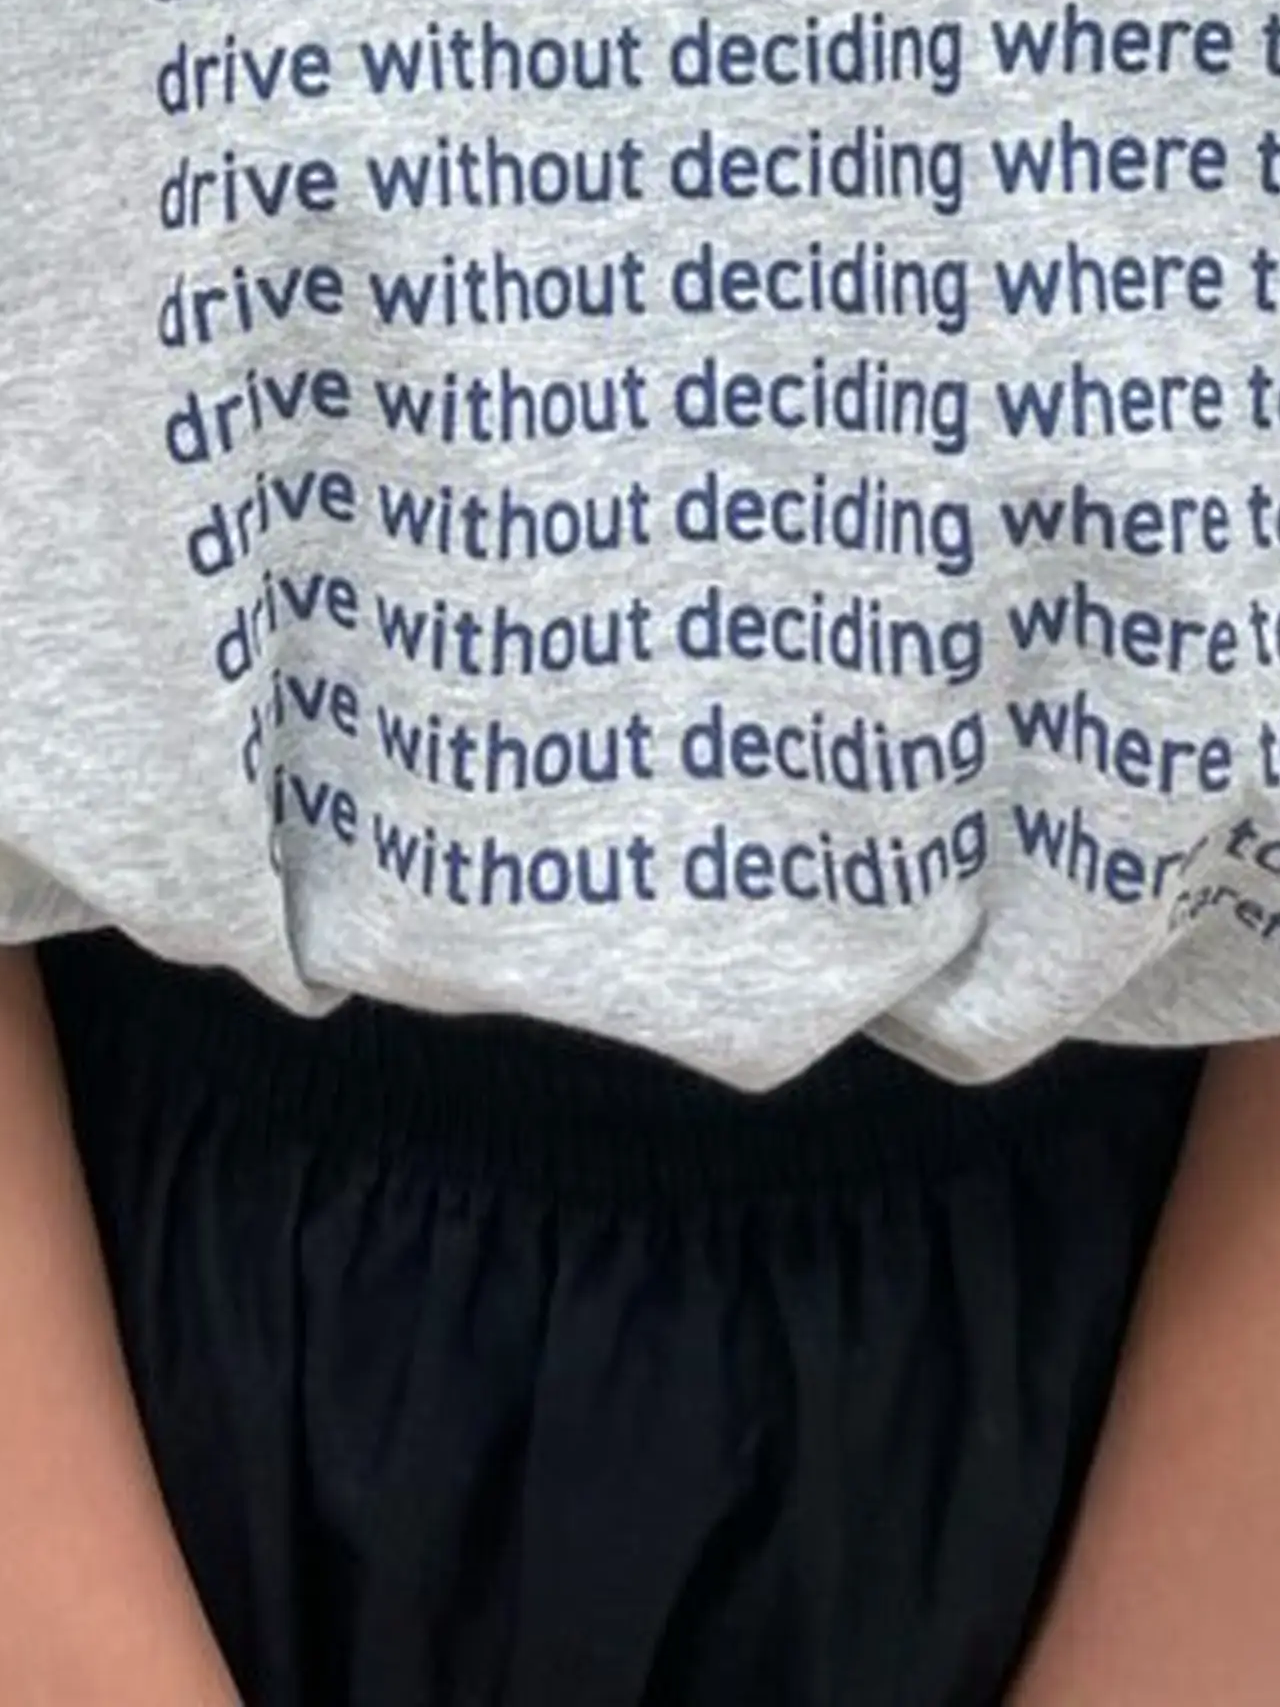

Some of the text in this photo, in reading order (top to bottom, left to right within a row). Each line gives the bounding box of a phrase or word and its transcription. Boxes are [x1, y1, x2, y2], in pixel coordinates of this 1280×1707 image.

[157, 33, 331, 117] drive
[359, 20, 643, 95] without
[669, 11, 962, 97] deciding
[990, 2, 1234, 76] where
[160, 149, 338, 230] drive
[366, 134, 644, 211] without
[670, 124, 964, 217] deciding
[990, 119, 1227, 195] where
[158, 264, 344, 348] drive
[368, 250, 646, 327] without
[671, 240, 968, 336] deciding
[994, 240, 1224, 316] where
[165, 367, 351, 465] drive
[374, 365, 650, 444] without
[673, 355, 968, 456] deciding
[995, 360, 1223, 439] where
[187, 470, 355, 578] drive
[378, 481, 651, 562] without
[675, 470, 975, 577] deciding
[999, 483, 1230, 557] where
[376, 596, 653, 677] without
[677, 585, 983, 687] deciding
[1007, 579, 1239, 675] where
[377, 705, 654, 794] without
[681, 703, 985, 793] deciding
[1006, 689, 1232, 795] where
[373, 813, 657, 907] without
[684, 809, 988, 908] deciding
[1013, 804, 1210, 904] wher
